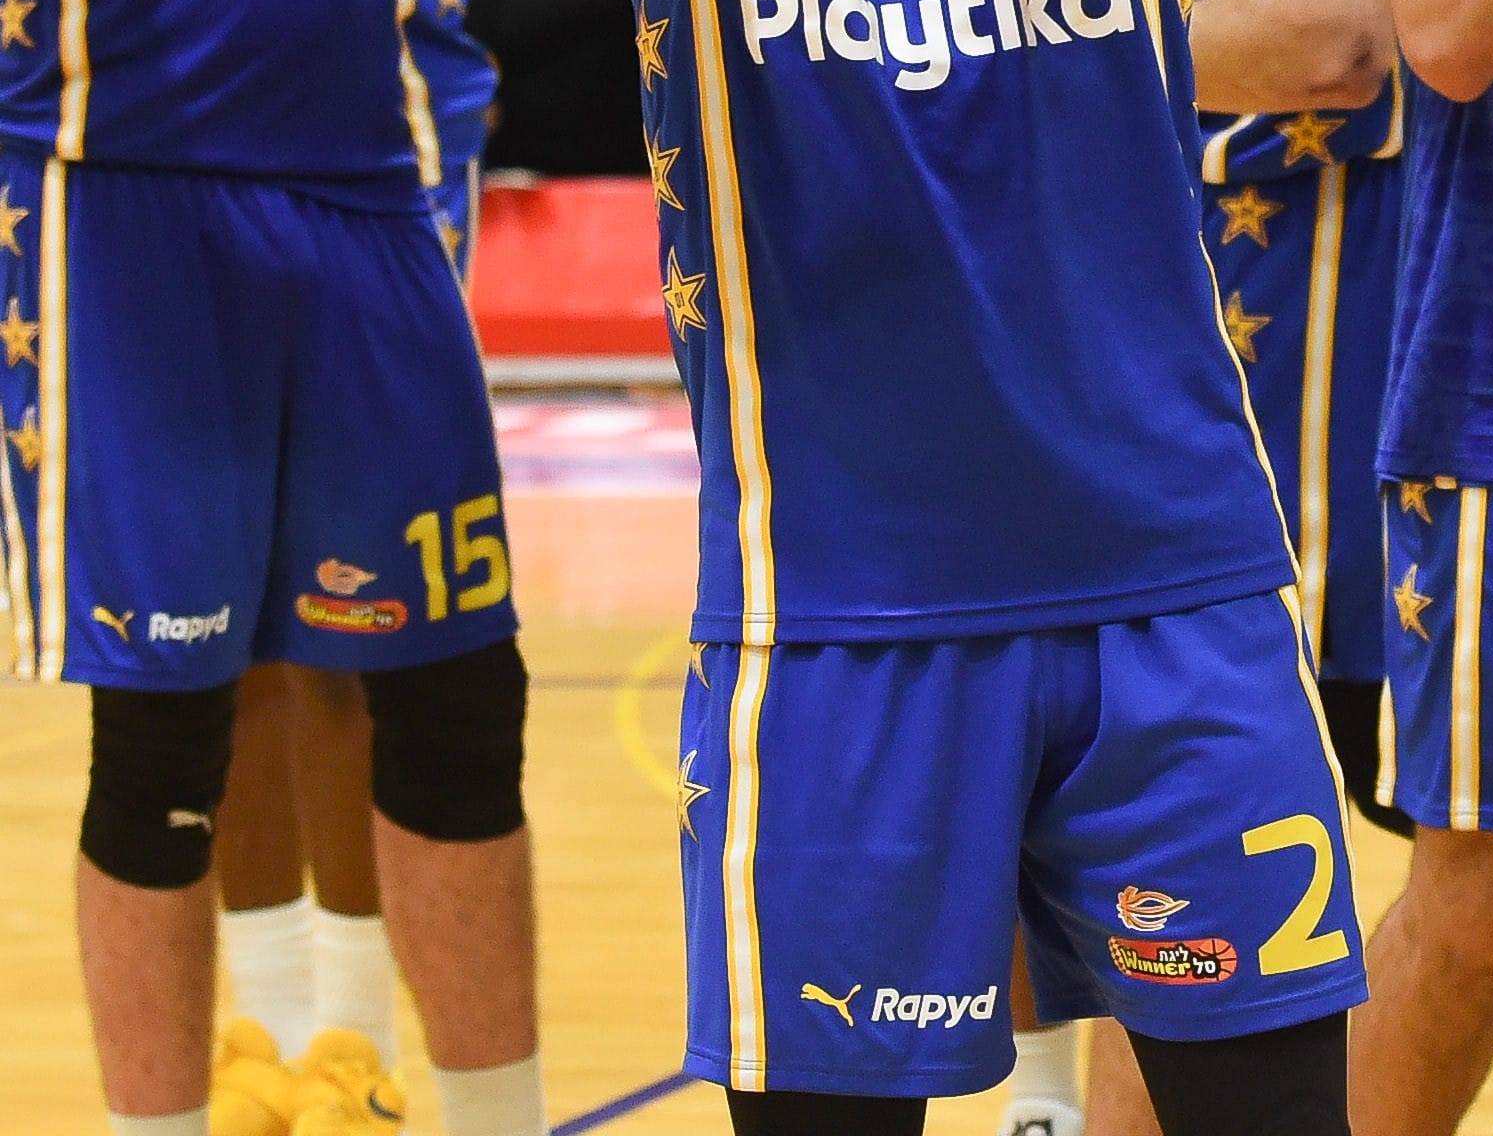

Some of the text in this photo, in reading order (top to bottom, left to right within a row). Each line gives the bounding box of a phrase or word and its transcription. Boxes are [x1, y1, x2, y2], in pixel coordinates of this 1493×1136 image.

[404, 492, 511, 622] 15
[148, 604, 231, 645] Rapyd
[1241, 813, 1351, 977] 2
[1119, 947, 1216, 976] Winner סל
[870, 984, 998, 1029] Rapyd
